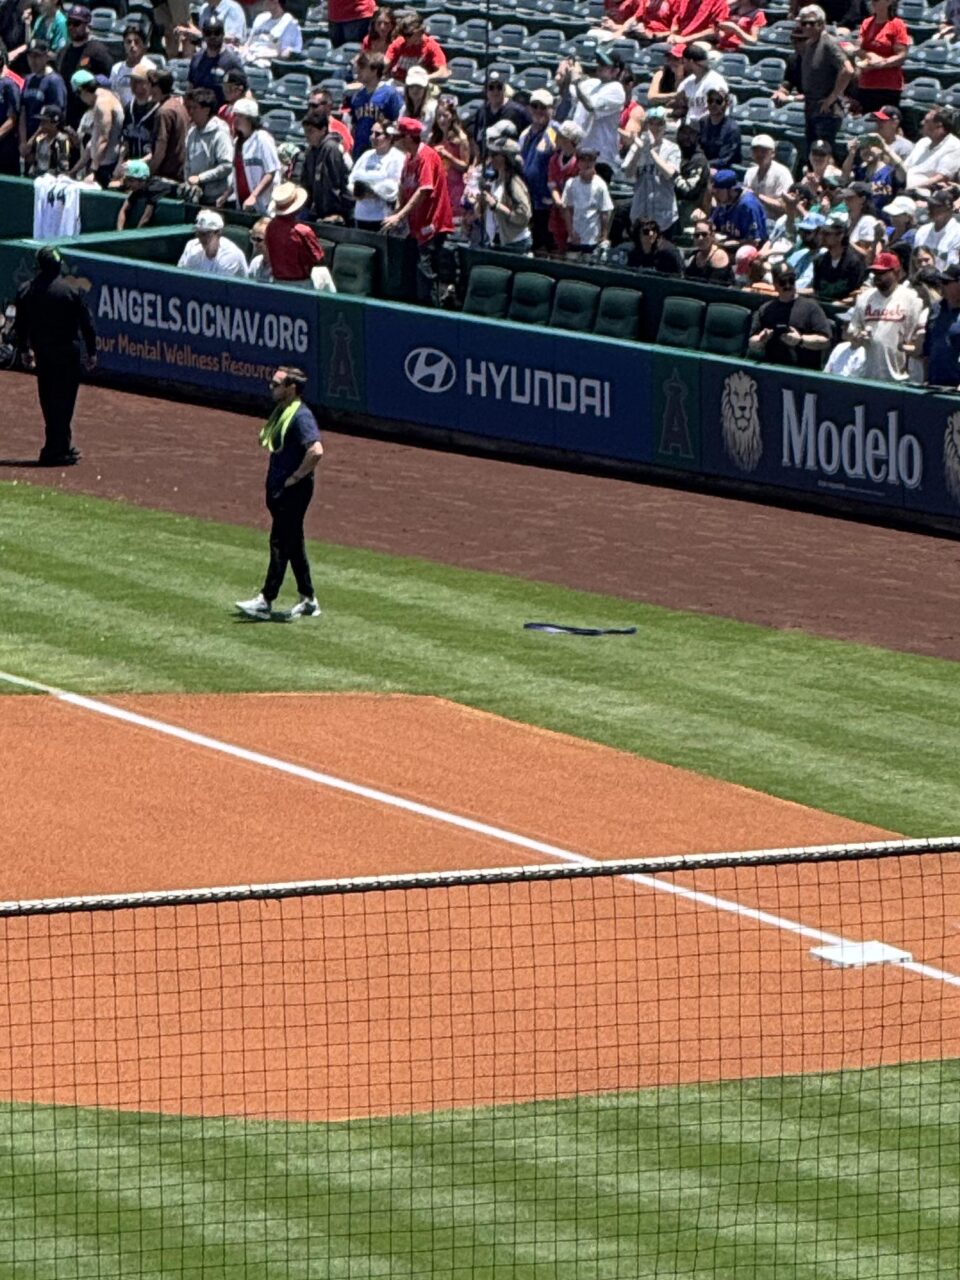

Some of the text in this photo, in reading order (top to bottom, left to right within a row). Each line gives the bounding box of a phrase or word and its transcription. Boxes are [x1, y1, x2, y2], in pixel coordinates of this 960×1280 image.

[97, 284, 309, 353] ANGELS.OCNAV.ORG
[95, 334, 277, 380] our Mental Wellness Resourc
[465, 358, 611, 418] HYUNDAI
[781, 387, 923, 490] Modelo
